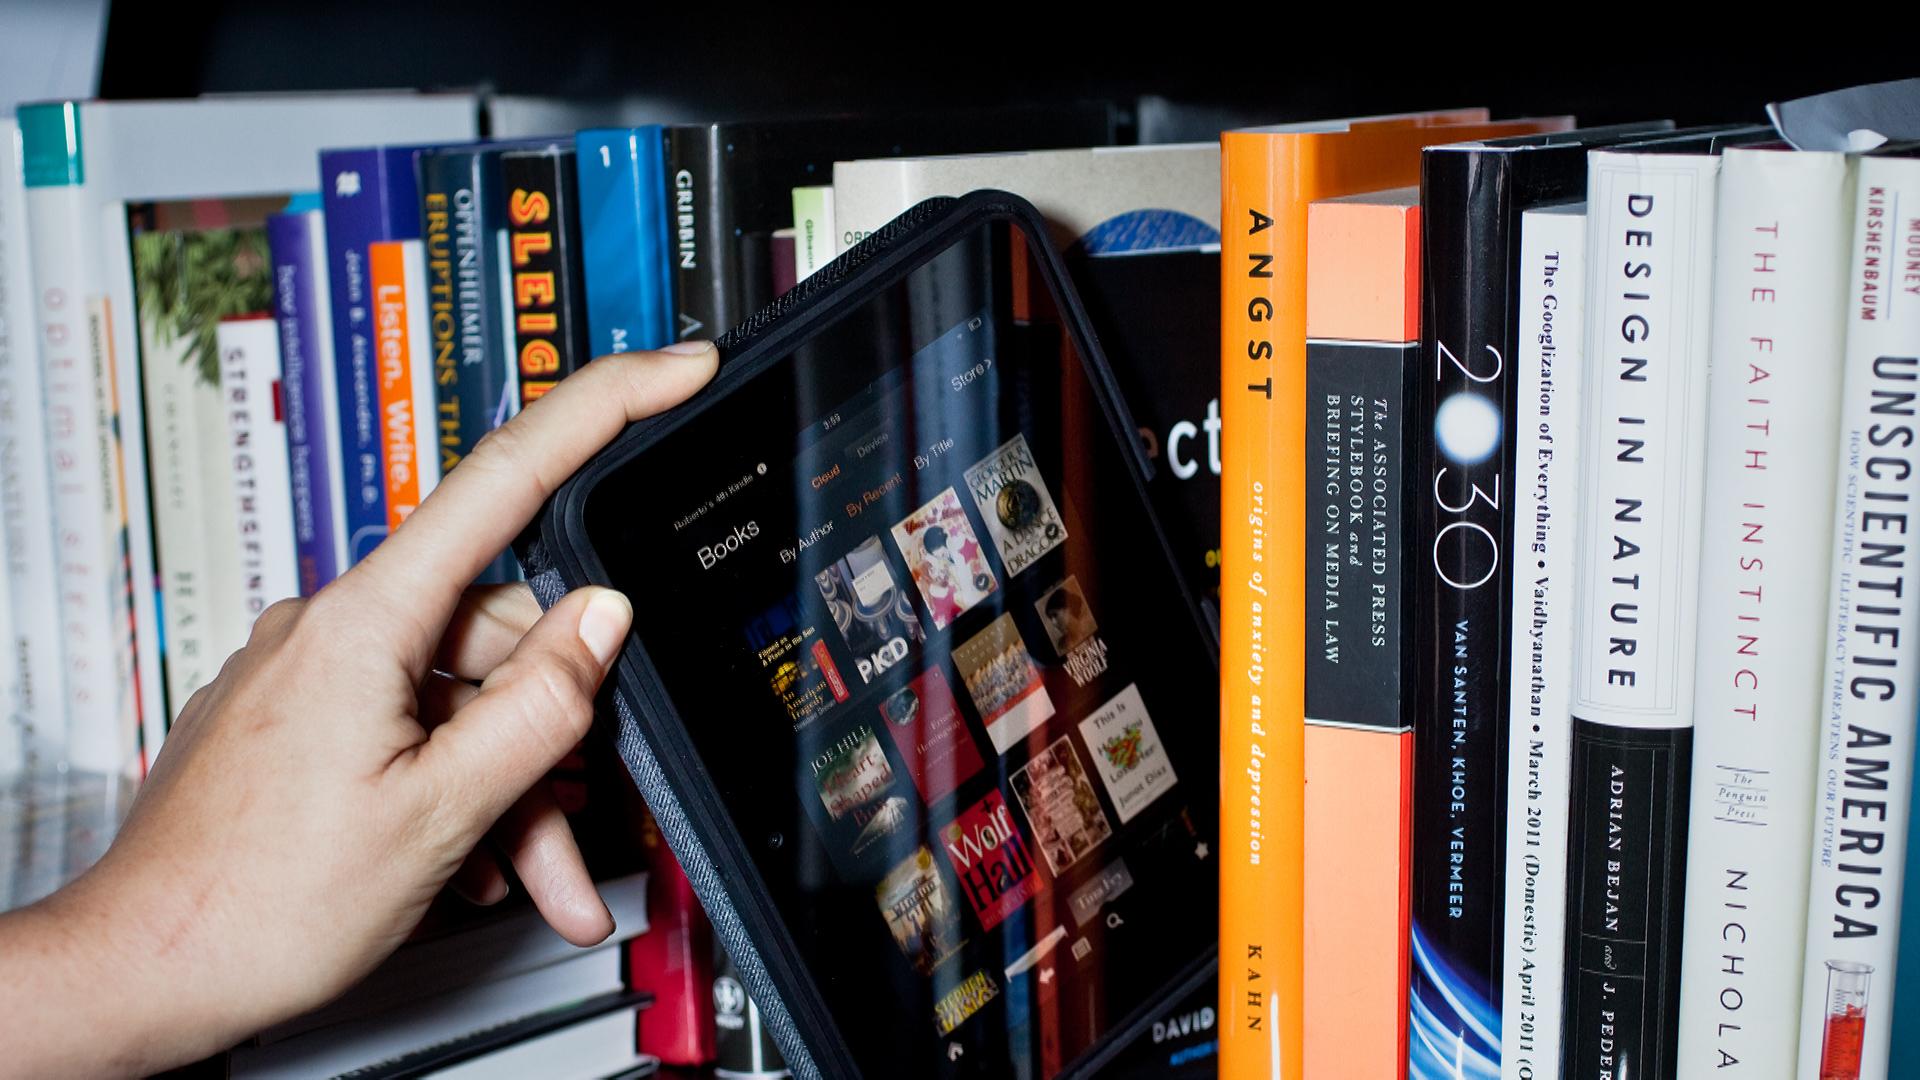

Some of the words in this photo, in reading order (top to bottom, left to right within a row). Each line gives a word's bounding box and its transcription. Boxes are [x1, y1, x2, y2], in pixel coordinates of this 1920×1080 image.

[676, 169, 697, 269] GRIBBIN
[1543, 251, 1559, 288] The
[1752, 221, 1778, 304] THE
[1861, 187, 1885, 320] KIRSHENBAUM
[278, 265, 297, 315] how
[425, 192, 459, 386] ERUPTIONS
[1248, 208, 1274, 400] ANGST
[1620, 194, 1654, 382] DESIGN
[378, 285, 405, 390] Listen.
[1538, 295, 1558, 416] Googlization
[282, 318, 307, 444] intelligence
[951, 362, 985, 392] Store
[1745, 337, 1773, 470] FAITH
[386, 399, 415, 493] Write.
[856, 432, 889, 458] Device
[1326, 395, 1341, 496] BRIEFING
[1373, 399, 1388, 431] The
[1539, 423, 1553, 443] of
[1617, 417, 1645, 463] IN
[811, 464, 841, 490] Cloud
[914, 453, 931, 471] By
[930, 436, 954, 457] Title
[975, 455, 1034, 506] MARTIN
[1349, 395, 1364, 524] STYLEBOOK
[1850, 430, 1861, 470] HOW
[291, 445, 316, 543] happens
[845, 500, 863, 519] By
[862, 472, 904, 507] Recent
[1248, 481, 1268, 563] origins
[1326, 504, 1340, 535] ON
[1372, 439, 1387, 575] ASSOCIATED
[1531, 450, 1552, 554] Everything
[1840, 475, 1859, 564] SCIENTIFIC
[697, 519, 760, 570] Books
[779, 544, 797, 565] By
[798, 520, 834, 551] Author
[1349, 533, 1363, 566] and
[1850, 355, 1918, 702] UNSCIENTIFIC
[1248, 573, 1268, 597] of
[1325, 543, 1340, 610] MEDIA
[1608, 498, 1643, 687] NATURE
[1325, 620, 1339, 664] LAW
[1371, 583, 1387, 647] PRESS
[1454, 619, 1469, 659] VAN
[1734, 503, 1766, 722] INSTINCT
[1834, 572, 1851, 662] ILLITERACY
[854, 636, 910, 684] PKD
[1063, 637, 1108, 677] VIRGINIA
[1071, 657, 1109, 687] WOOLF
[1248, 602, 1267, 688] anxiety
[1529, 577, 1549, 717] Vaidhyanathan
[1093, 711, 1116, 730] This
[1115, 702, 1126, 714] Is
[1249, 694, 1266, 737] and
[1452, 666, 1468, 751] SANTEN,
[1827, 669, 1845, 760] THREATENS
[810, 748, 834, 778] JOE
[836, 724, 873, 754] HILL
[1526, 740, 1544, 800] March
[1733, 773, 1752, 784] The
[1247, 744, 1266, 866] depression
[1450, 758, 1466, 818] KHOE,
[1608, 765, 1625, 852] ADRIAN
[1718, 787, 1767, 805] Penguin
[1727, 805, 1756, 818] Press
[1825, 769, 1838, 802] OUR
[948, 803, 1013, 869] Wolf
[1526, 808, 1542, 846] 2011
[1820, 806, 1836, 869] FUTURE
[1832, 724, 1892, 939] AMERICA
[961, 836, 1034, 912] Hall
[1449, 827, 1464, 919] VERMEER
[1519, 854, 1541, 953] (Domestic)
[1606, 860, 1622, 932] BEJAN
[1247, 944, 1263, 1033] KAHN
[1517, 958, 1537, 1009] April
[1603, 982, 1616, 1000] J.
[1717, 868, 1748, 1069] NICHOLA
[1152, 1006, 1215, 1044] DAVID
[1518, 1012, 1535, 1056] 2011
